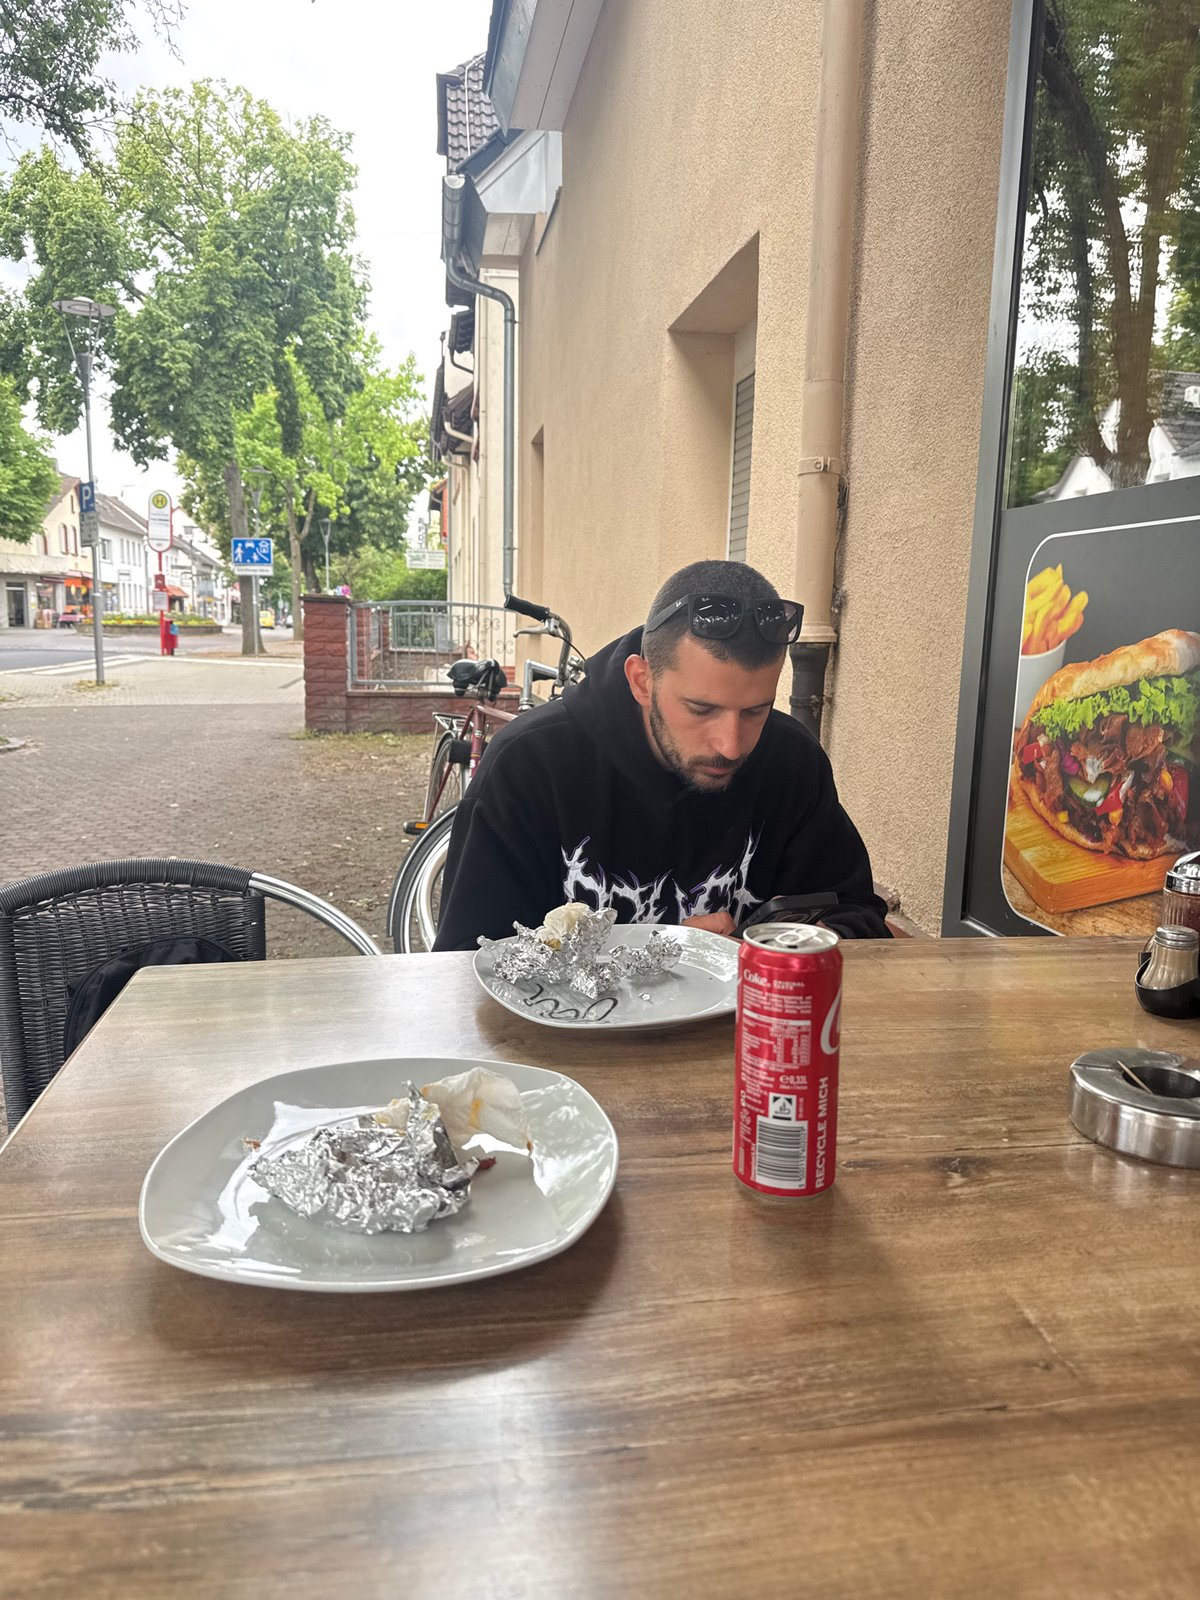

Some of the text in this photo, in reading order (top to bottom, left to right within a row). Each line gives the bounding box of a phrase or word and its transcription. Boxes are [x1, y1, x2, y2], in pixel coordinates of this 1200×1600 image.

[82, 486, 92, 509] P
[815, 1077, 828, 1188] RECYCLE MICH
